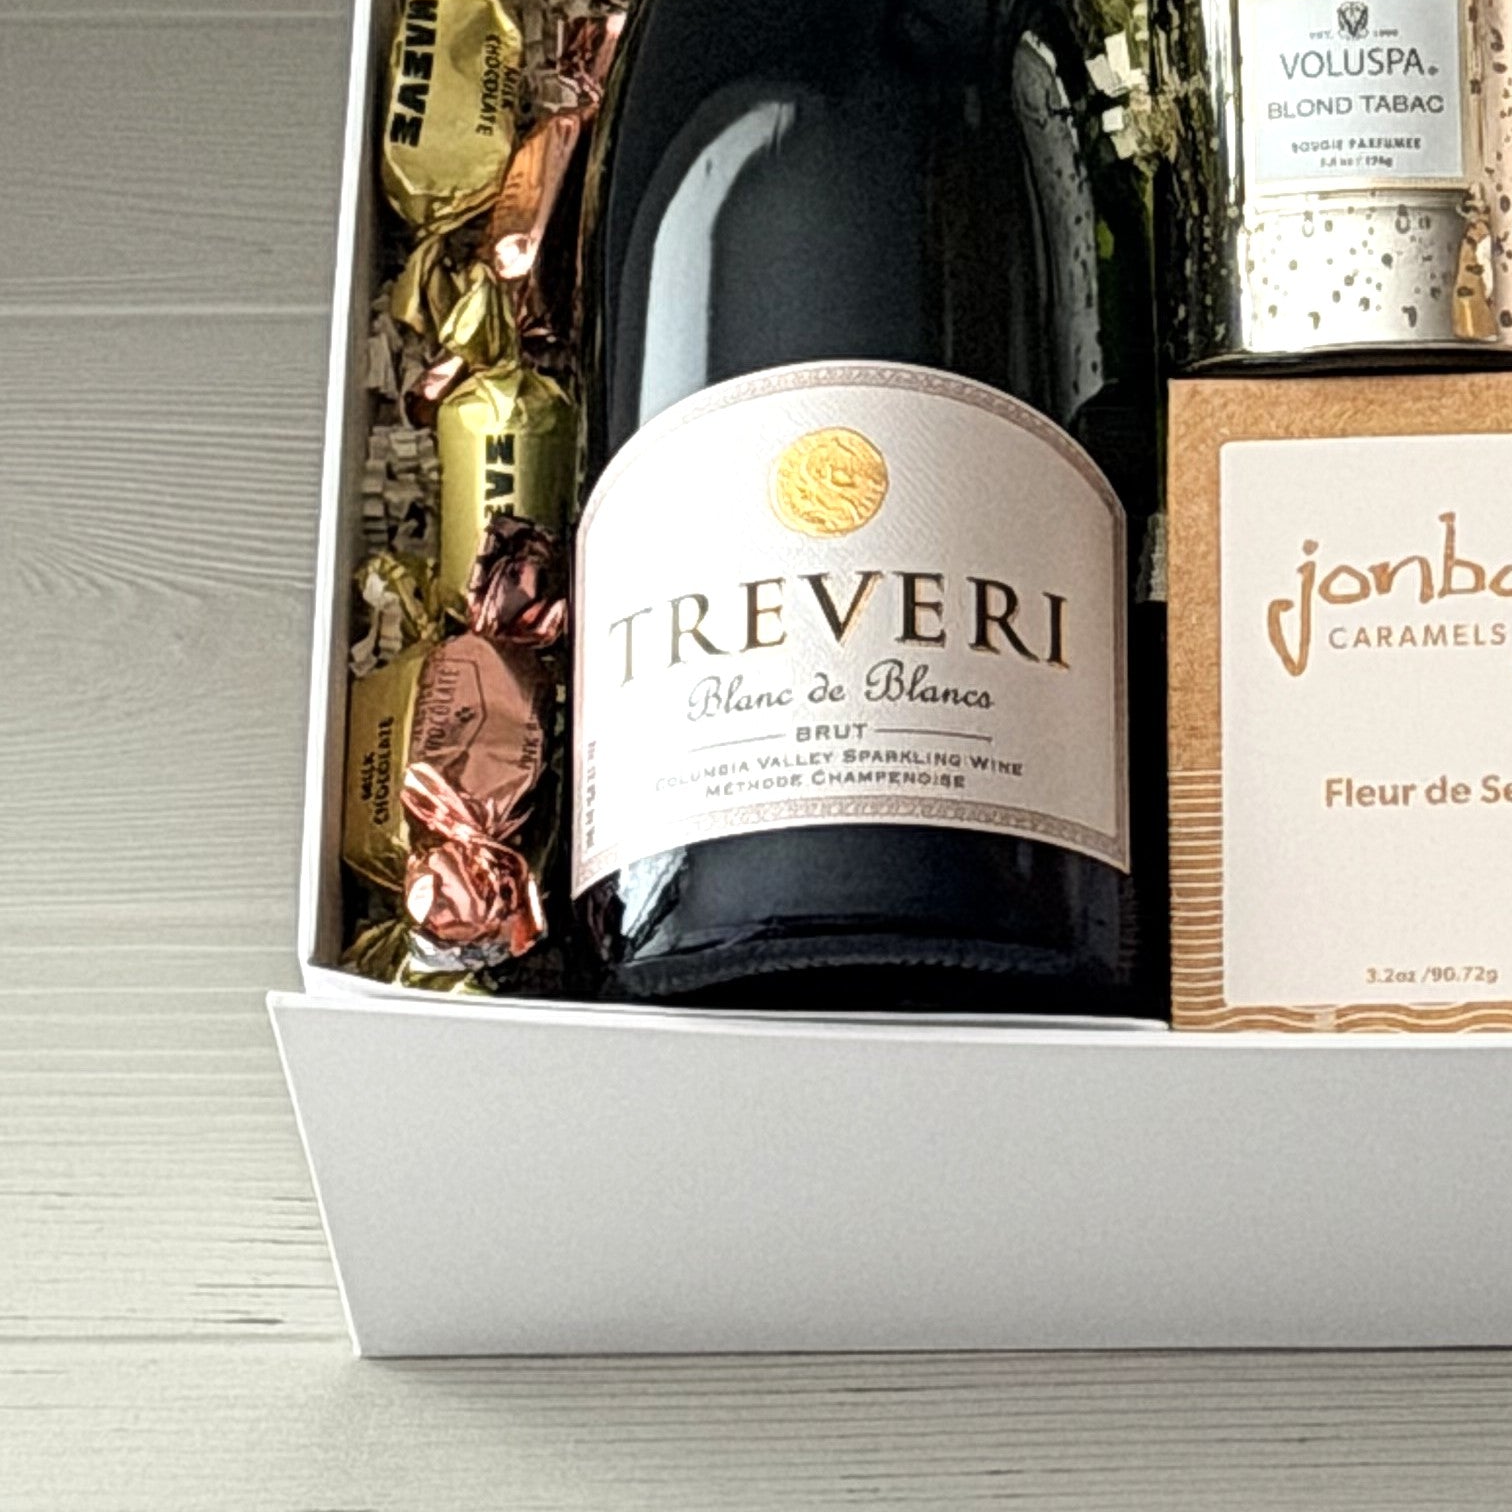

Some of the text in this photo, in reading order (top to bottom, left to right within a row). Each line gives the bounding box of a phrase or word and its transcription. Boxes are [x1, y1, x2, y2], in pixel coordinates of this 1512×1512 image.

[475, 34, 502, 138] CHOCOLATE
[1267, 94, 1445, 120] BLOND TABAC
[608, 570, 1072, 688] TREVERI
[1328, 622, 1508, 652] CARAMELS
[687, 657, 996, 722] Blanc de Blancs
[795, 722, 868, 743] BRUT
[757, 750, 834, 771] VALLEY
[842, 748, 962, 768] SPARKLING
[970, 754, 1024, 777] WINE
[811, 768, 967, 789] CHAMPENOISE
[1323, 776, 1418, 809] Fleur
[1424, 774, 1471, 806] de
